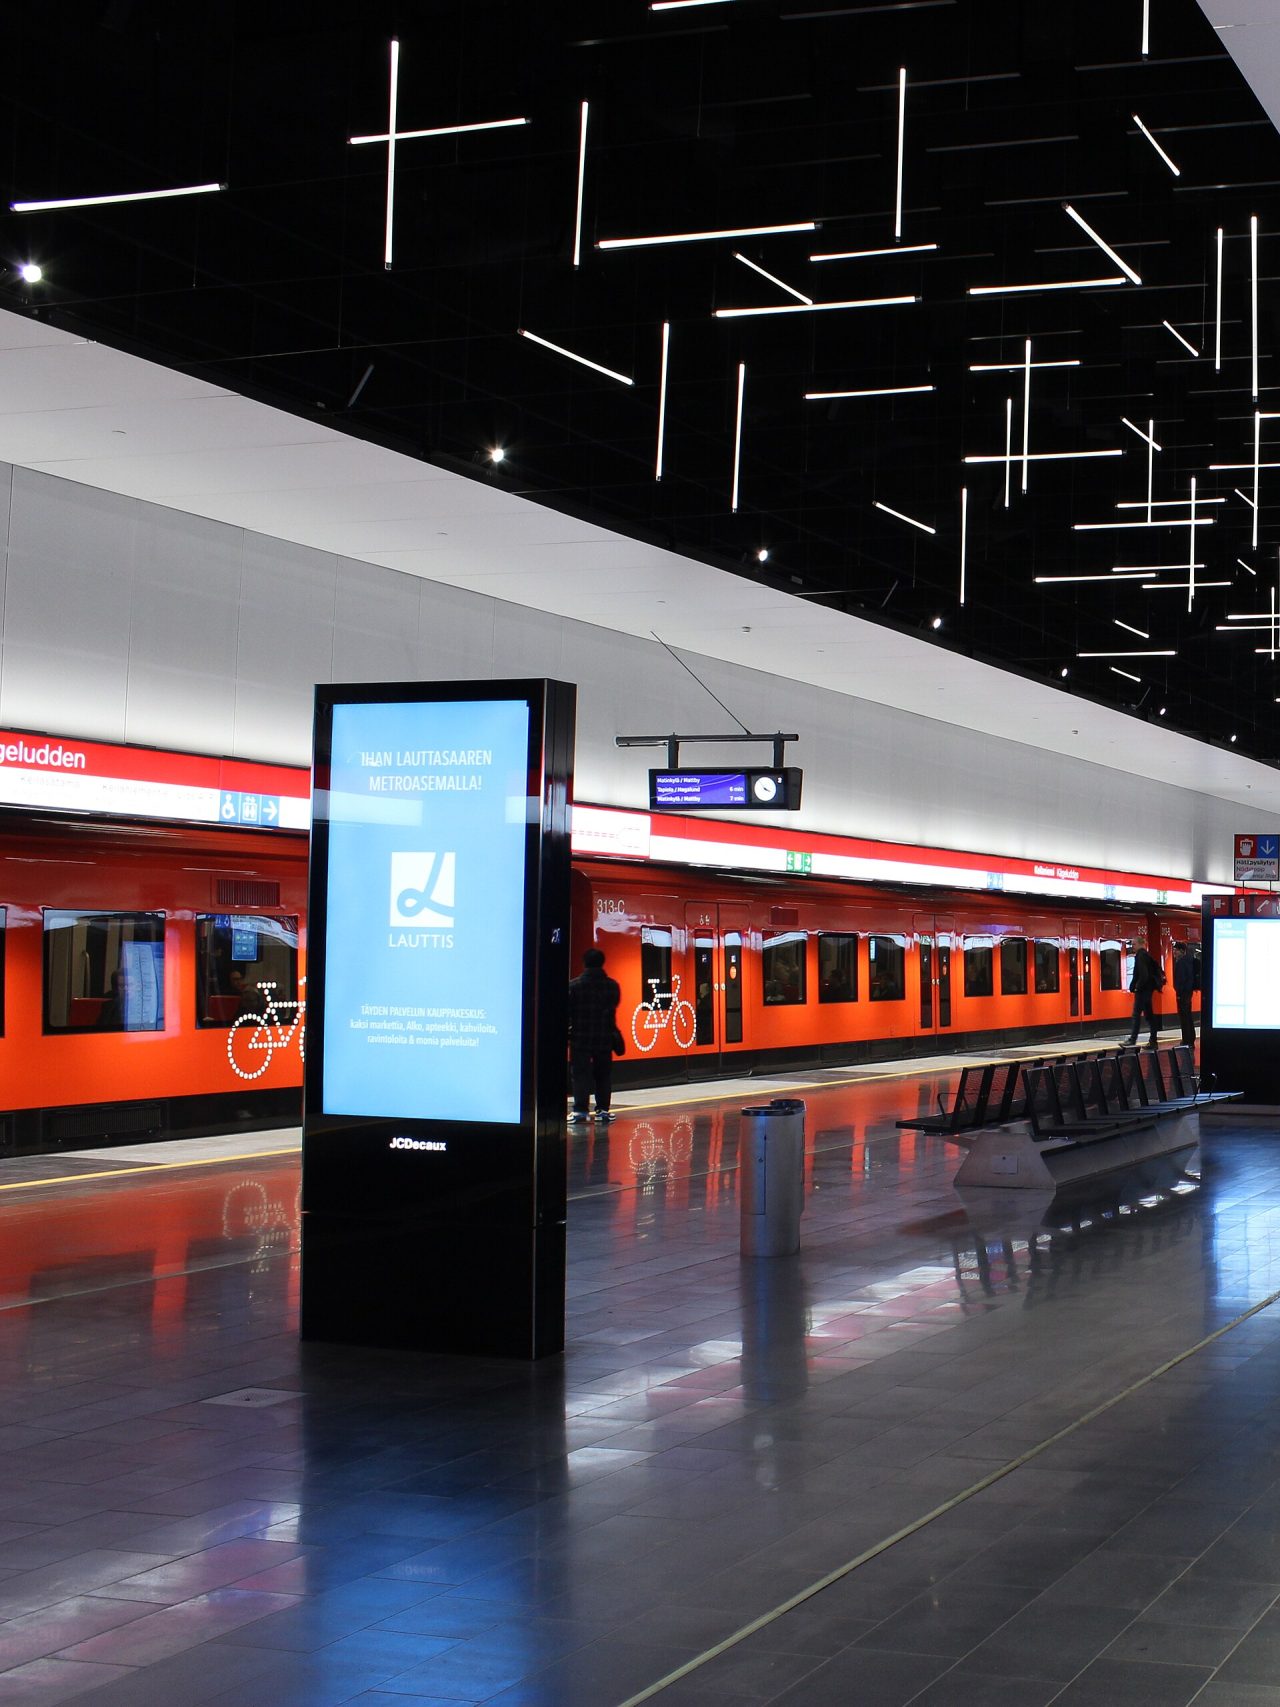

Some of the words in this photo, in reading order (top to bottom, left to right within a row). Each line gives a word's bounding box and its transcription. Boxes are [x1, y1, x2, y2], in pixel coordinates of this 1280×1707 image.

[0, 740, 86, 769] geludden
[361, 751, 392, 767] IHAN
[396, 750, 492, 767] LAUTTASAAREN
[369, 775, 482, 791] METROASEMALLA!
[596, 899, 625, 914] 313-C
[388, 933, 454, 949] LAUTTIS
[361, 1004, 388, 1016] TÄYDEN
[389, 1006, 426, 1018] PALVELUN
[427, 1007, 487, 1019] KAUPPAKESKUS:
[350, 1018, 369, 1029] kaksi
[369, 1020, 405, 1031] markettia,
[406, 1021, 424, 1032] Alko,
[425, 1022, 459, 1034] apteekki,
[460, 1023, 498, 1035] kahviloita,
[367, 1034, 407, 1045] ravintoloita
[409, 1035, 415, 1045] &
[416, 1036, 439, 1046] monia
[440, 1037, 480, 1048] palveluita!
[390, 1137, 447, 1151] JCDecaux
